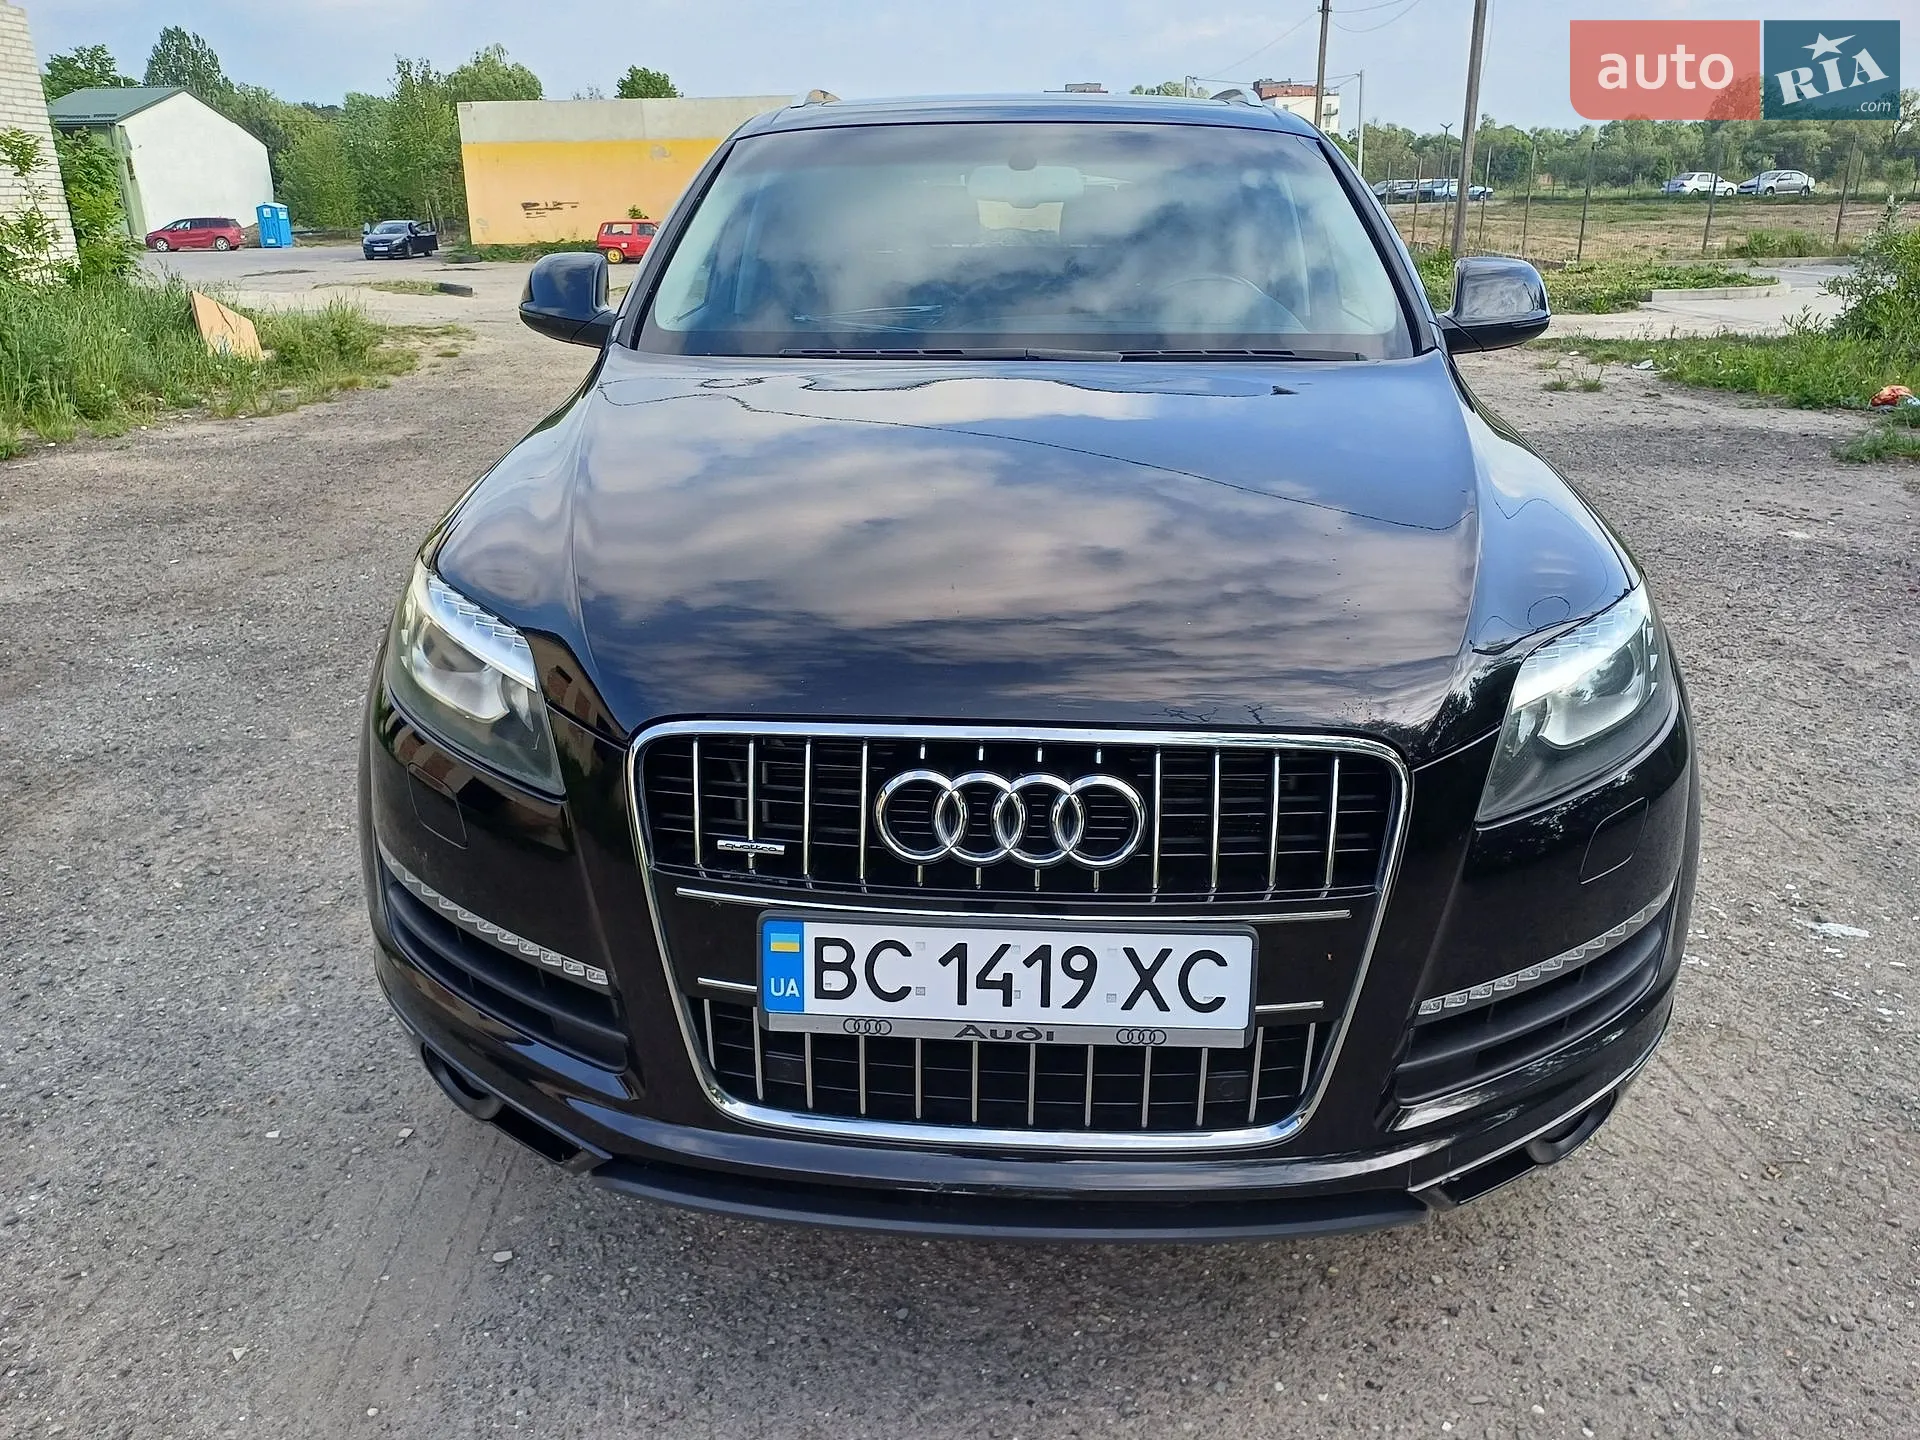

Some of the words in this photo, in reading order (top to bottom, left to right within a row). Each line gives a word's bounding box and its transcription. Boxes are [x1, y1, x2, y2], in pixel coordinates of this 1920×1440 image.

[724, 843, 777, 853] quattro
[814, 936, 913, 1003] BC
[937, 942, 1099, 1009] 1419
[1120, 946, 1229, 1013] XC
[770, 976, 800, 998] UA
[953, 1024, 1055, 1042] Audi
